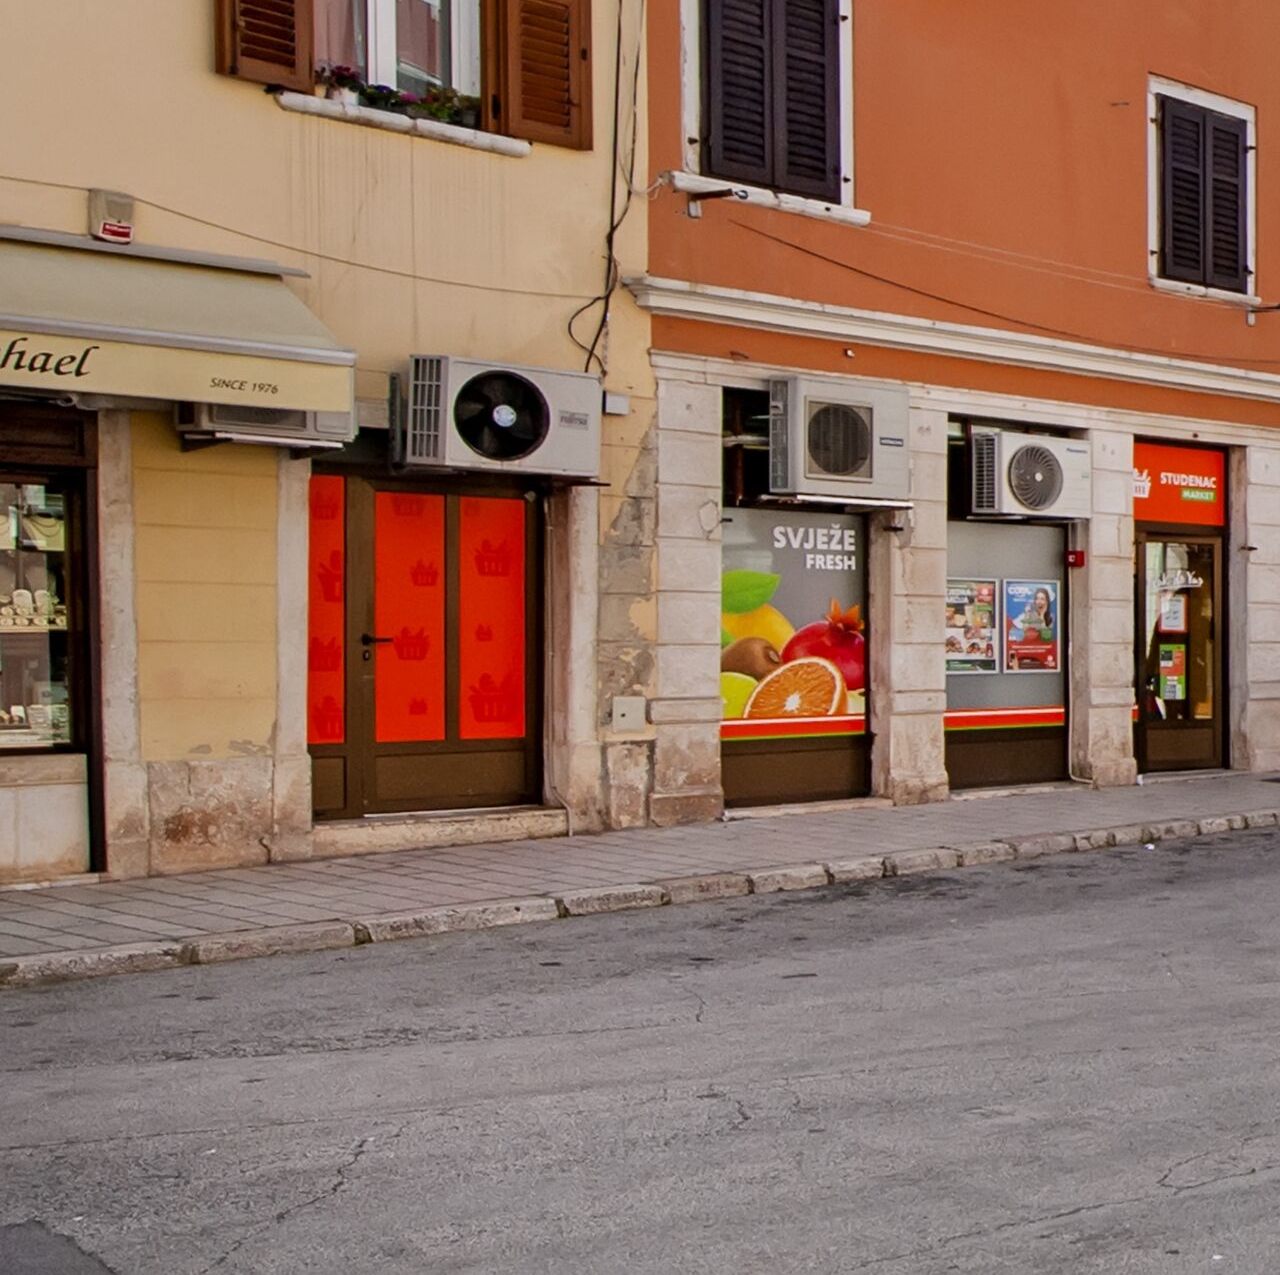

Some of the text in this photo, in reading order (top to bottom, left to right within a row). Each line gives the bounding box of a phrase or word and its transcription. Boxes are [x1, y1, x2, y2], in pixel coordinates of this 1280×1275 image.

[0, 337, 100, 377] hael
[210, 377, 279, 394] SINCE 1976
[1160, 471, 1217, 489] STUDENAC
[1183, 490, 1214, 501] MARKET
[773, 523, 856, 551] SVJEŽE
[806, 554, 856, 570] FRESH
